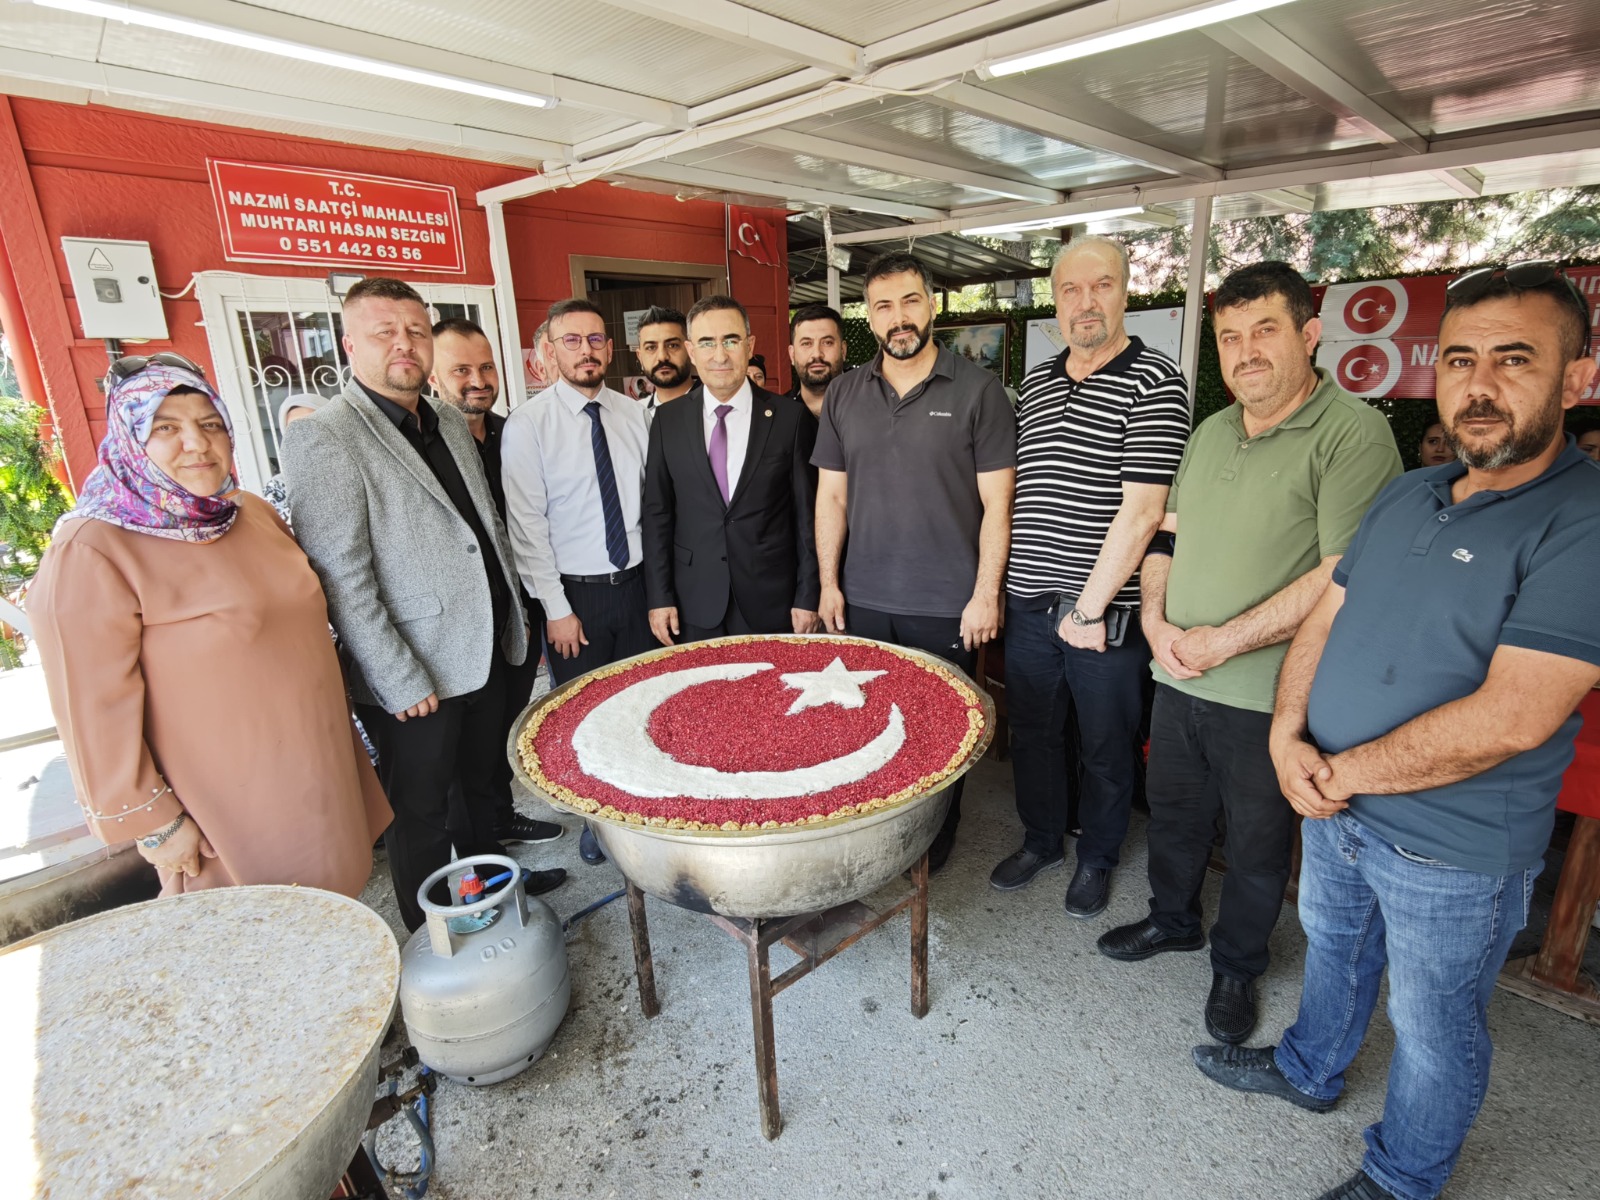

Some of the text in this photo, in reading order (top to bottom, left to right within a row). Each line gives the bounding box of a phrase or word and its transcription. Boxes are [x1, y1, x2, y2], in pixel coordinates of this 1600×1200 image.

[328, 181, 361, 197] T.C.
[228, 190, 449, 227] NAZMİ SAATÇİ MAHALLESİ
[240, 213, 446, 245] MUHTARI HASAN SEZGİN
[279, 237, 422, 260] 0 551 442 63 56
